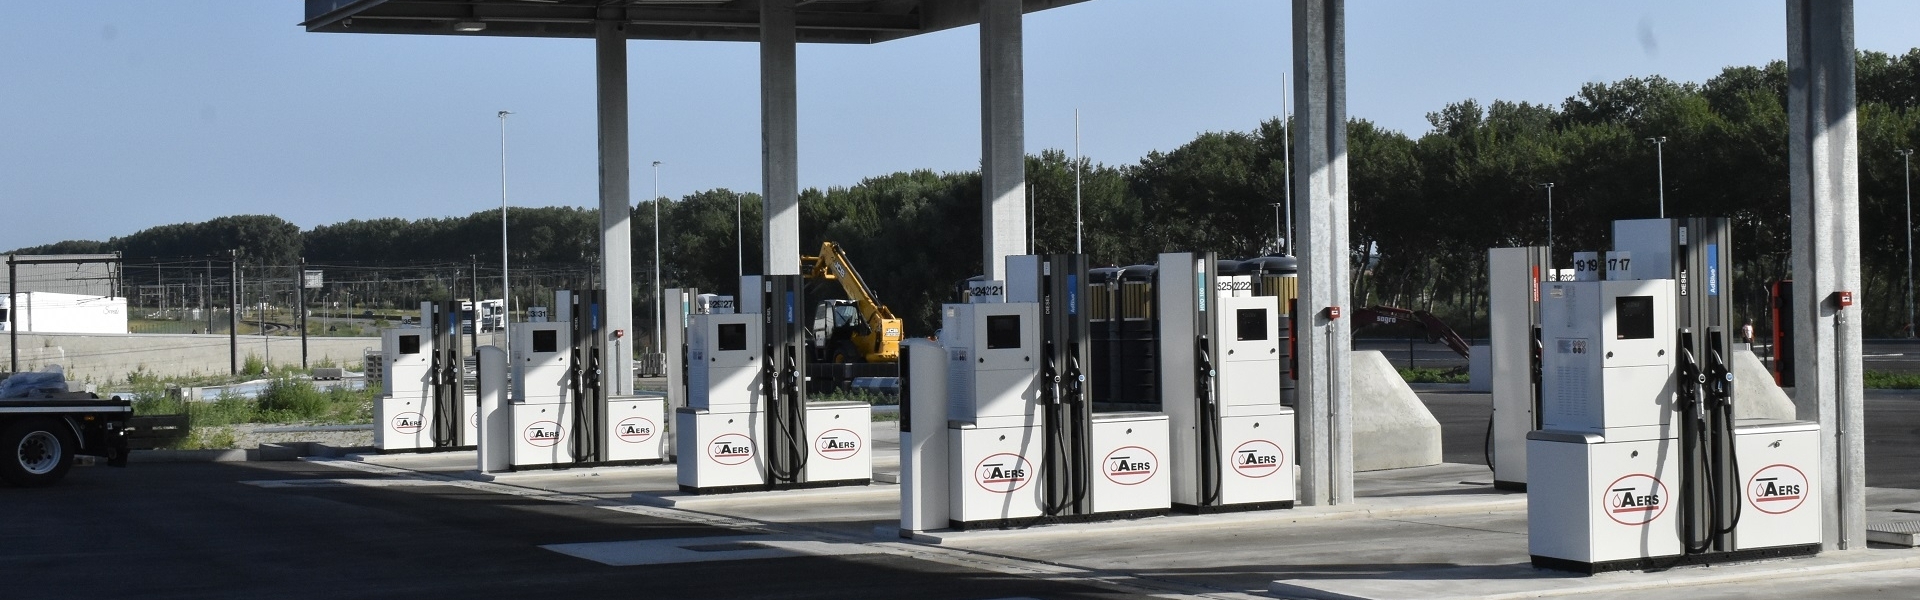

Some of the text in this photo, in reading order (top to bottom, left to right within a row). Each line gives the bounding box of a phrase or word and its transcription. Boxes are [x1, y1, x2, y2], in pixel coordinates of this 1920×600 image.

[1576, 259, 1597, 271] 19 19
[1608, 259, 1630, 270] 17 17
[975, 286, 986, 297] 24
[992, 286, 1003, 296] 21
[1240, 282, 1251, 290] 22
